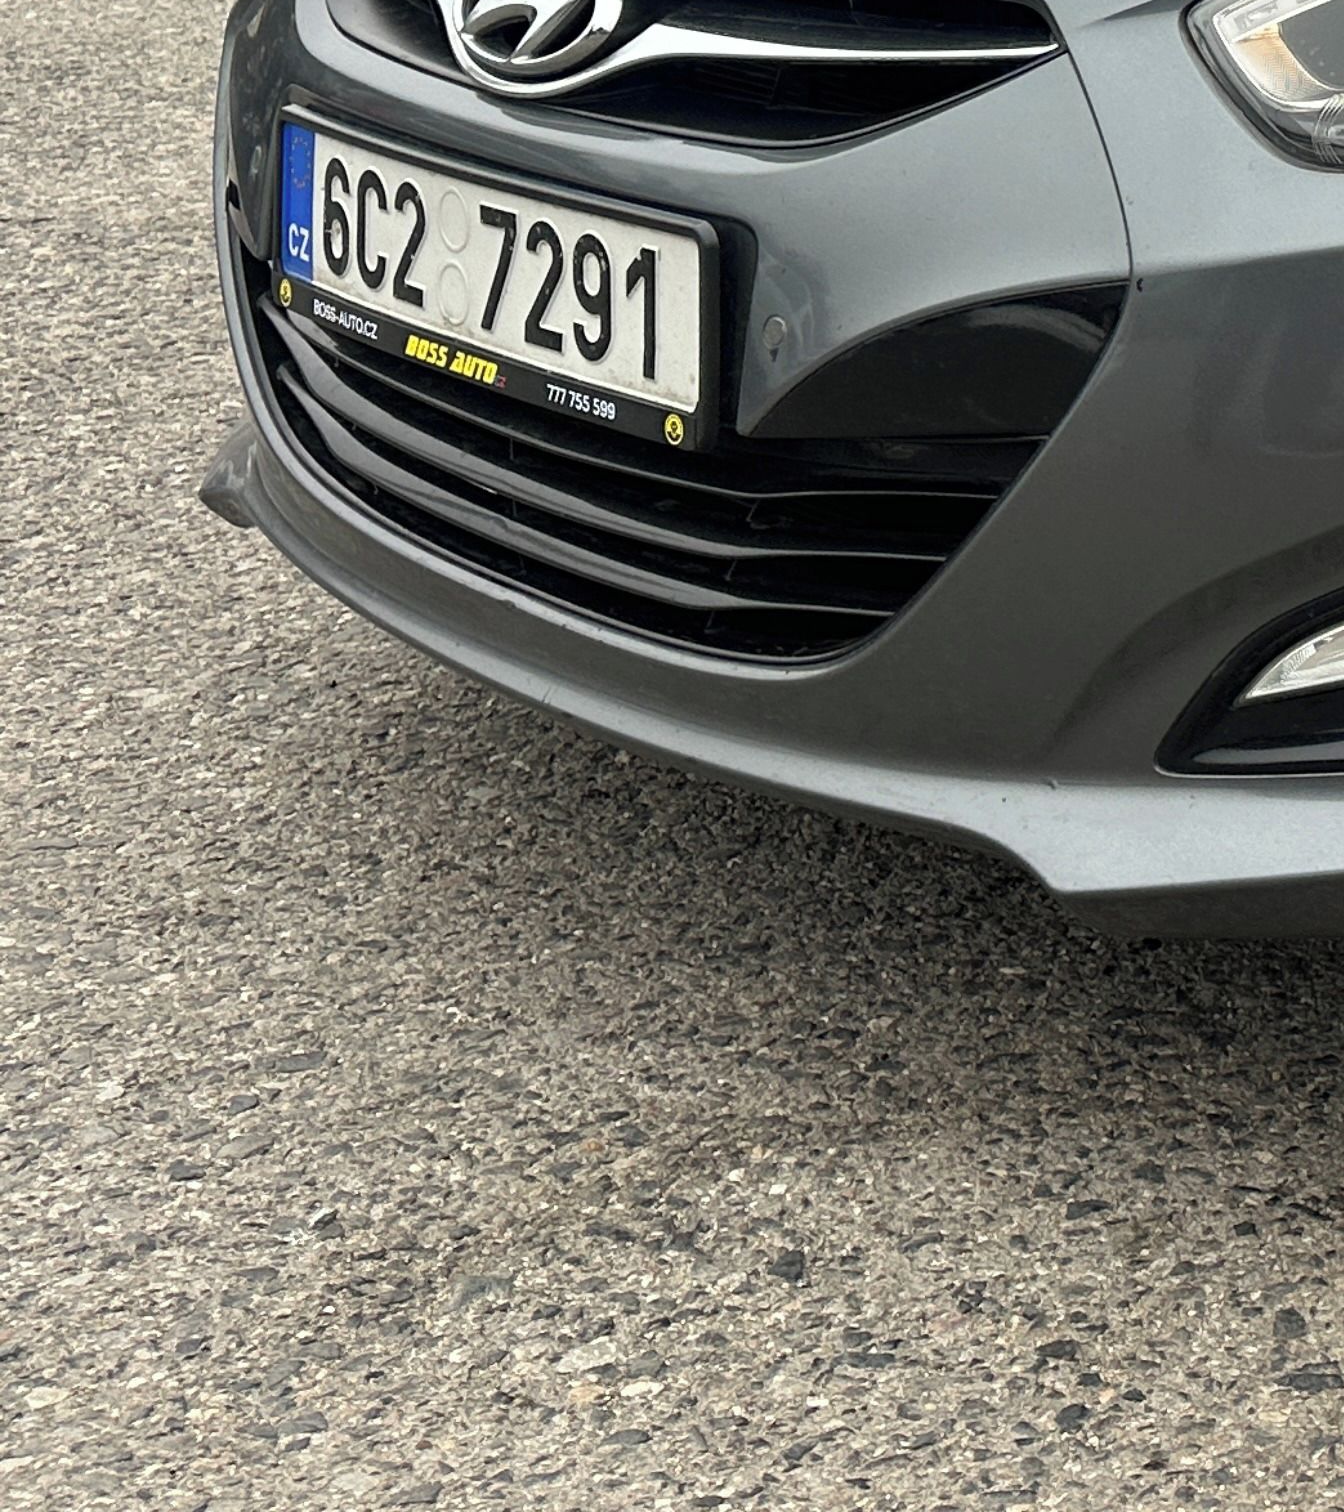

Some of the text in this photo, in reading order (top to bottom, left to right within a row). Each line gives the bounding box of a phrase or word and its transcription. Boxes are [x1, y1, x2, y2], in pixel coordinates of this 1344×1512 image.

[288, 156, 659, 380] CZ 6C2 7291
[313, 298, 379, 340] BOSS-AUTO.CZ
[404, 334, 499, 385] BOSS AUTO
[546, 383, 616, 421] 777 755 599
